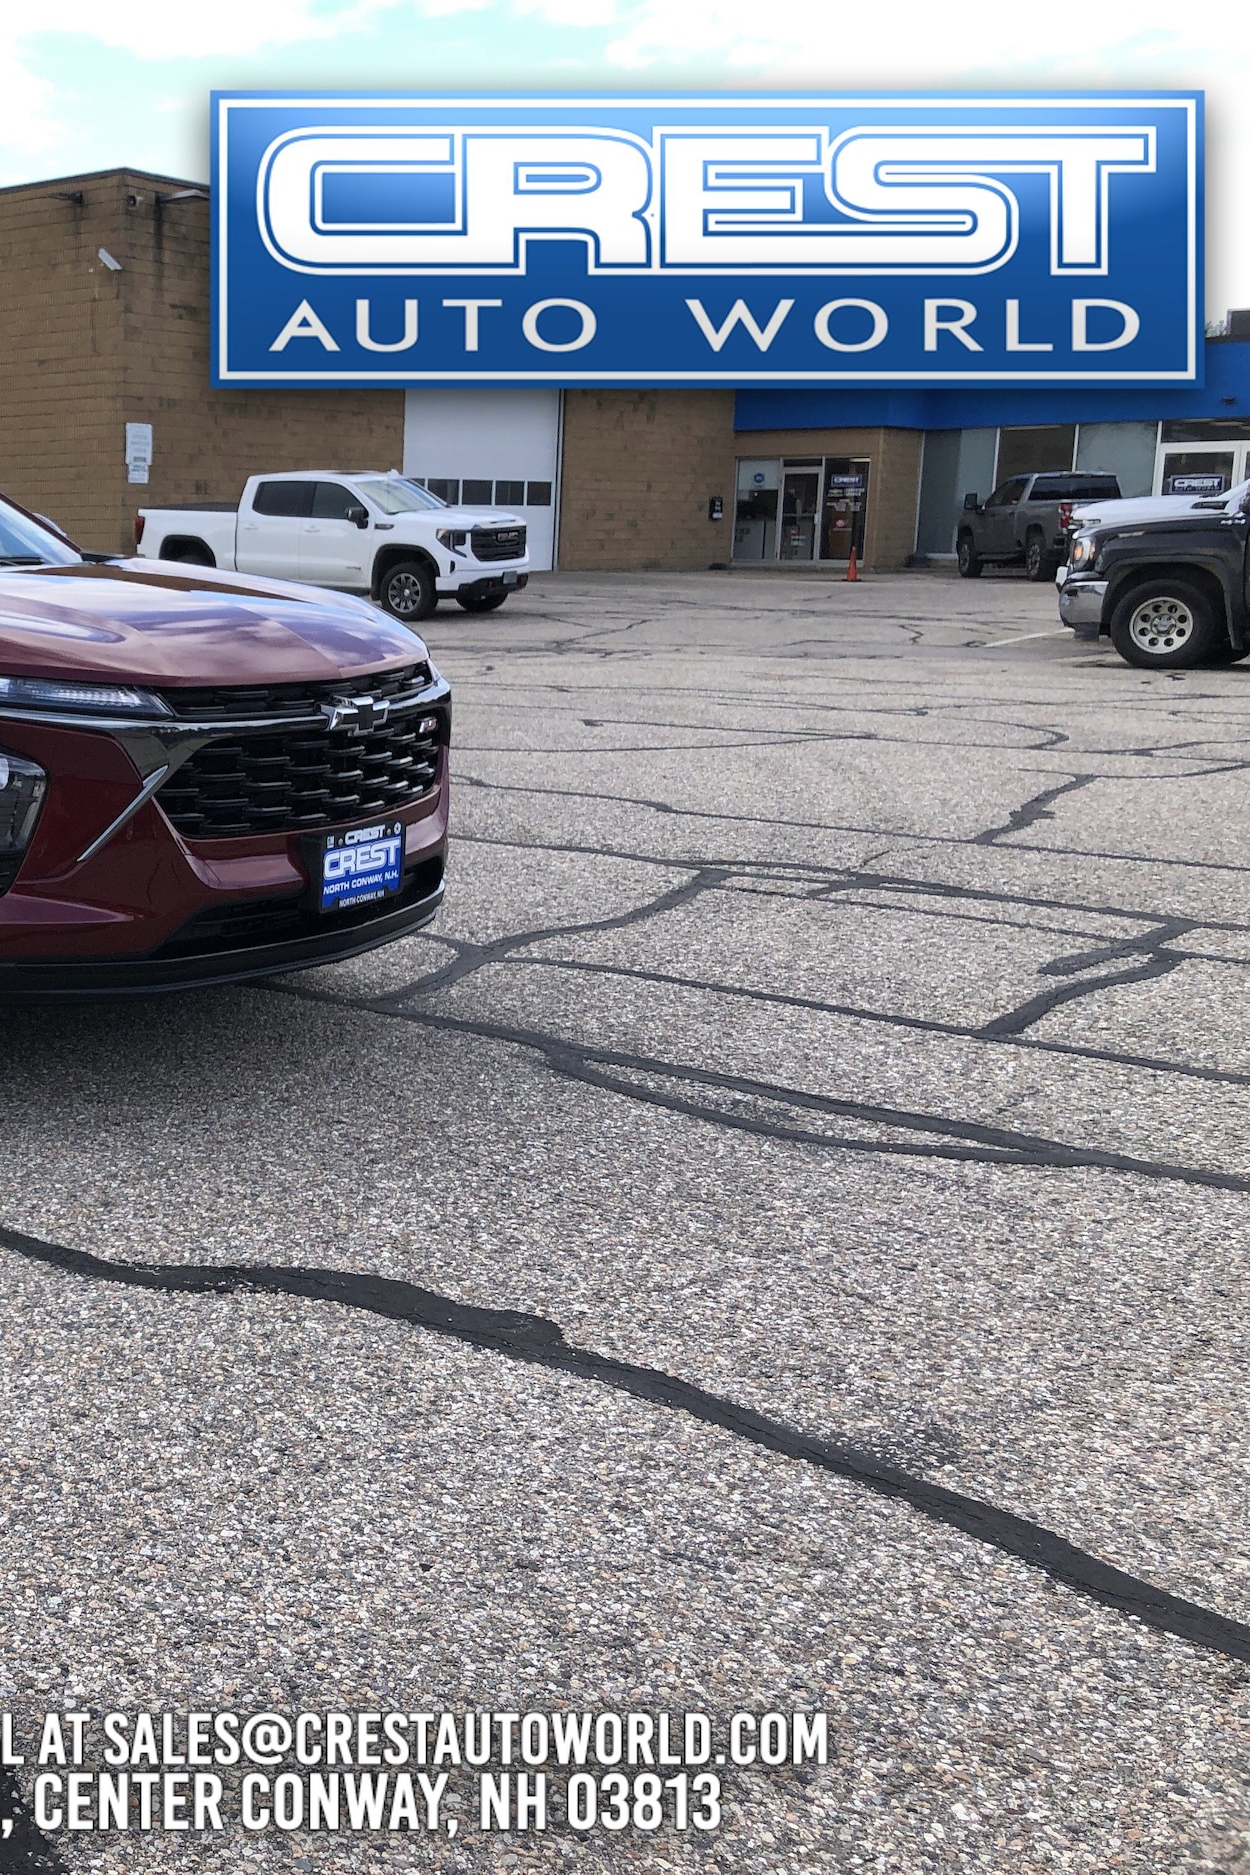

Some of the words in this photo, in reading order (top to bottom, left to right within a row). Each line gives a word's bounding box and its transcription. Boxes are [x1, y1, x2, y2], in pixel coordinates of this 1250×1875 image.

[344, 824, 386, 846] CREST
[323, 836, 402, 880] CREST
[323, 881, 350, 895] NORTH
[351, 873, 383, 888] CONWAY,
[339, 895, 357, 908] NORTH
